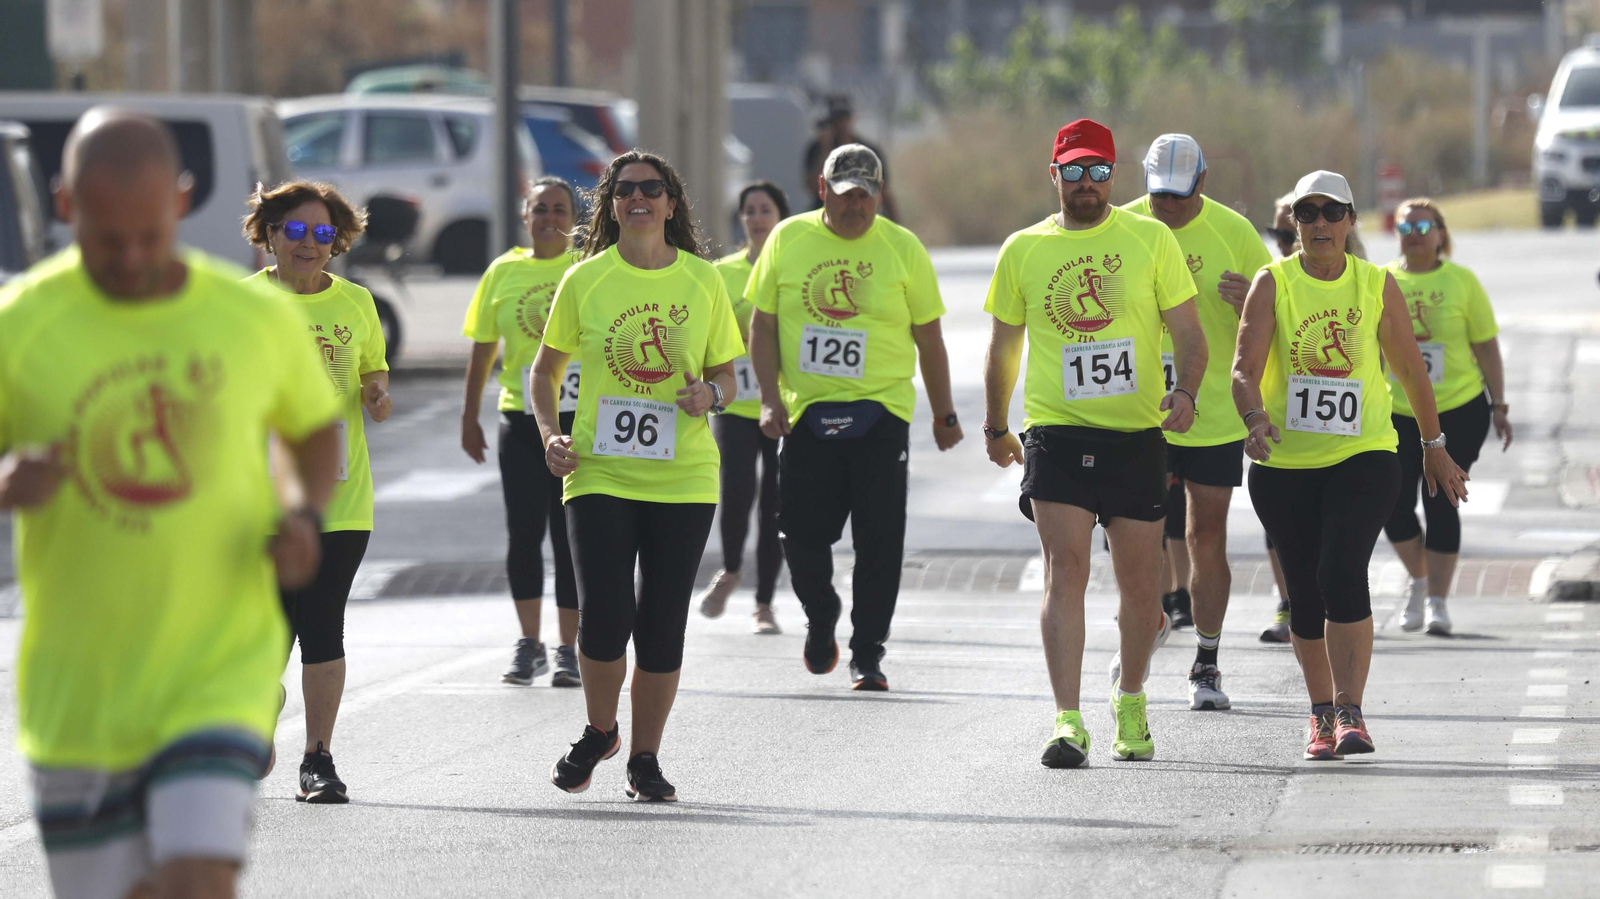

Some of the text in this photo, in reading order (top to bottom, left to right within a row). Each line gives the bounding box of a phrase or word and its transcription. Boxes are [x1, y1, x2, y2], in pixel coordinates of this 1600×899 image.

[806, 259, 849, 280] POPULAR
[802, 281, 824, 322] CARRERA
[1044, 255, 1096, 344] VII CARRERA POPULAR
[1295, 309, 1338, 338] POPULAR
[604, 303, 659, 395] VII CARRERA POPULAR
[807, 336, 861, 368] 126
[1071, 345, 1092, 353] CARRERA
[1092, 343, 1116, 351] SOLIDARIA
[1069, 350, 1133, 387] 154
[1299, 378, 1321, 386] CARRERA
[632, 402, 658, 410] SOLIDARIA
[658, 405, 674, 413] APRON
[821, 416, 853, 425] Reebok
[1295, 387, 1358, 423] 150
[613, 410, 659, 447] 96
